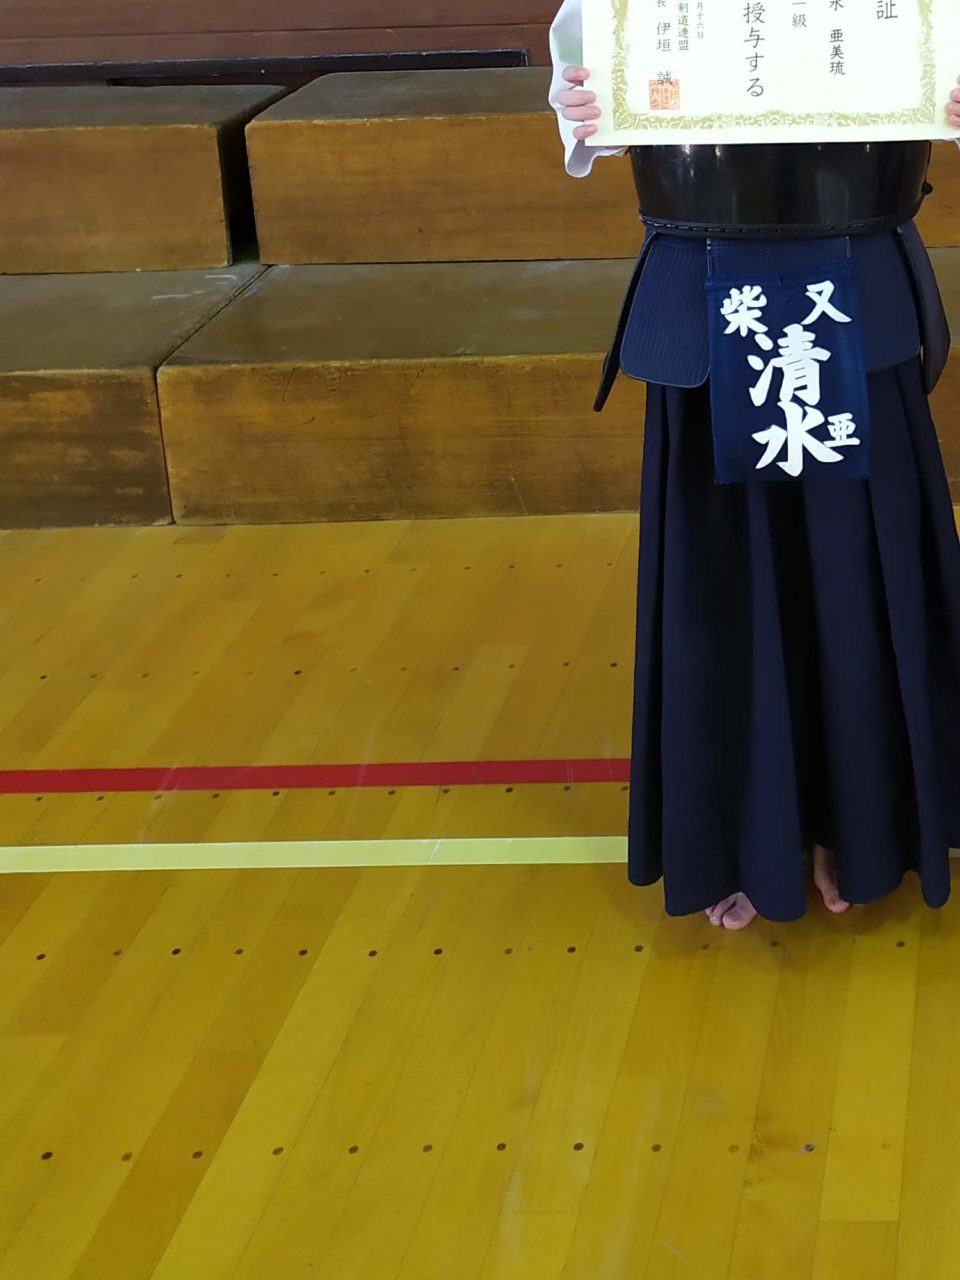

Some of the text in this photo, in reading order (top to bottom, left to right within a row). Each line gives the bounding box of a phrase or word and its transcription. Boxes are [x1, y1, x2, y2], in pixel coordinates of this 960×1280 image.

[829, 29, 846, 77] 亜美琉
[746, 323, 845, 478] 清水
[823, 412, 861, 448] 亜
